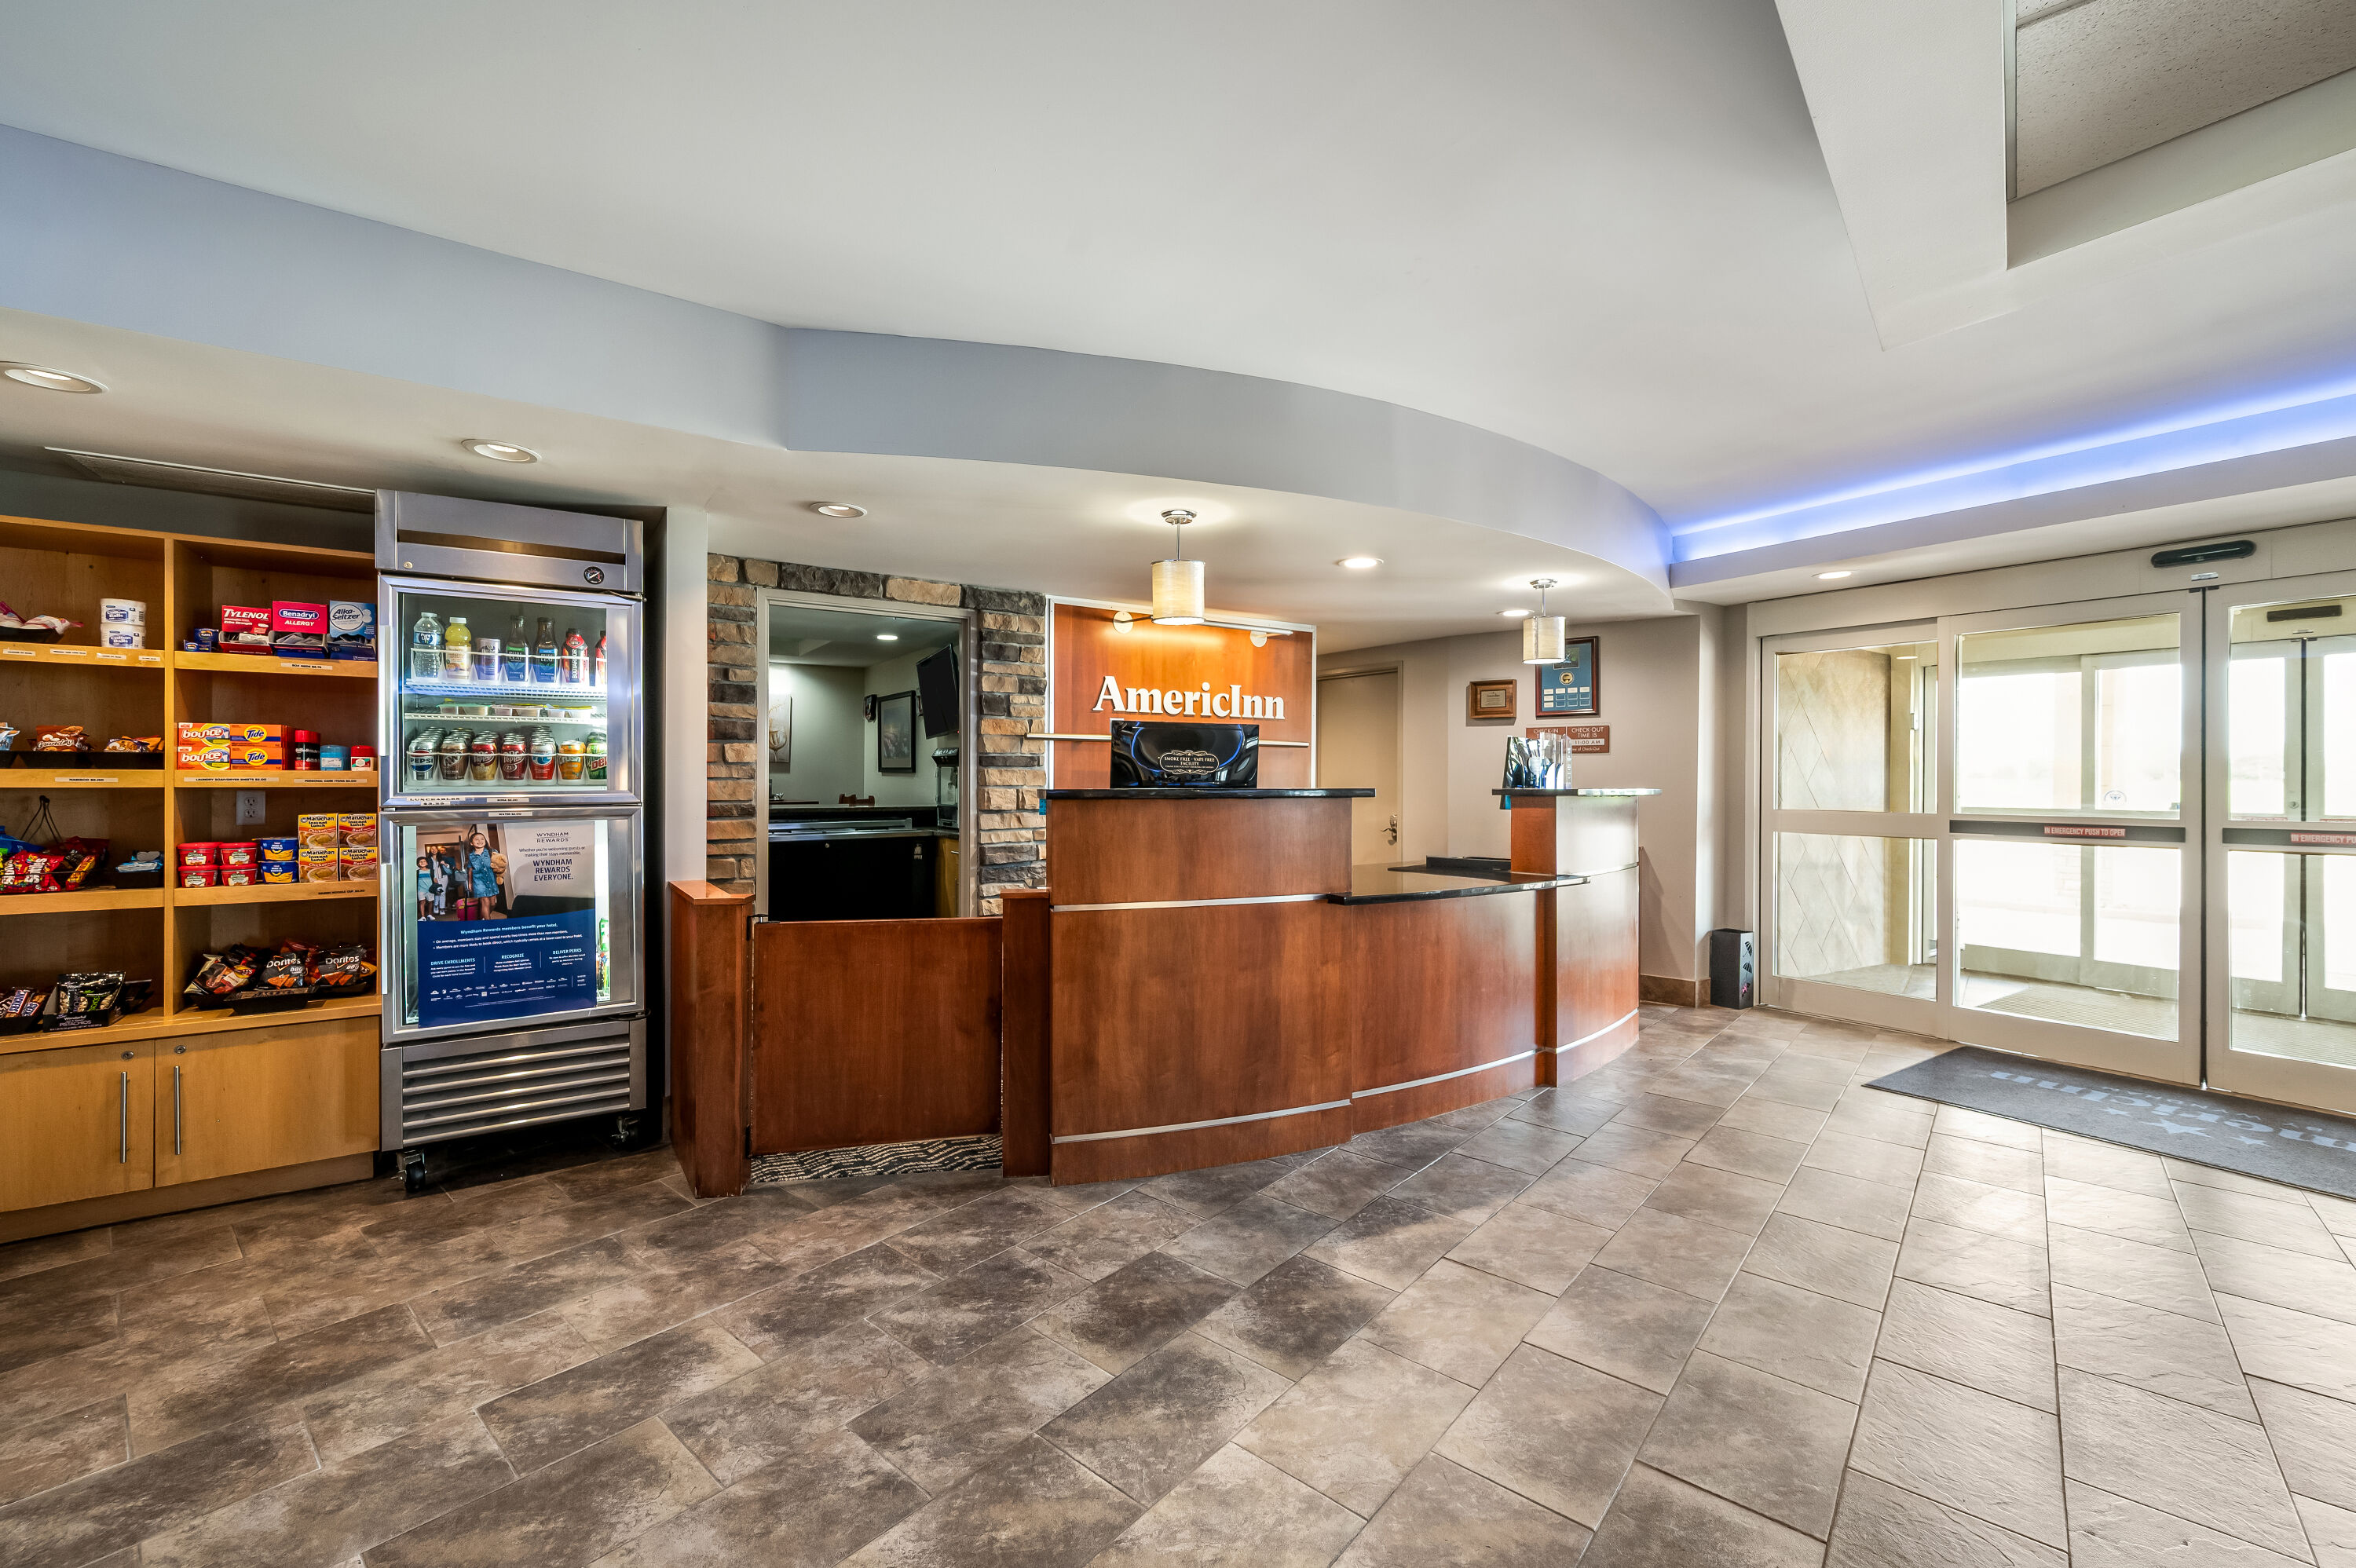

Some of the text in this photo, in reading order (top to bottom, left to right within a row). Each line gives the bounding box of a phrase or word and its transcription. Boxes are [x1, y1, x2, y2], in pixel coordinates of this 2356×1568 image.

[223, 609, 269, 620] TYLENOL
[1092, 675, 1286, 720] AmericInn
[181, 728, 222, 738] bounce
[247, 729, 265, 739] Tide
[181, 751, 221, 762] bounce
[247, 752, 265, 762] Tide
[2300, 834, 2344, 843] EMERGENCY
[2347, 835, 2356, 844] PU
[532, 858, 573, 867] WYNDHAM
[534, 873, 574, 882] EVERYONE.
[266, 958, 302, 969] Doritos
[325, 955, 360, 965] Doritos
[1989, 1070, 2356, 1153] mericInn
